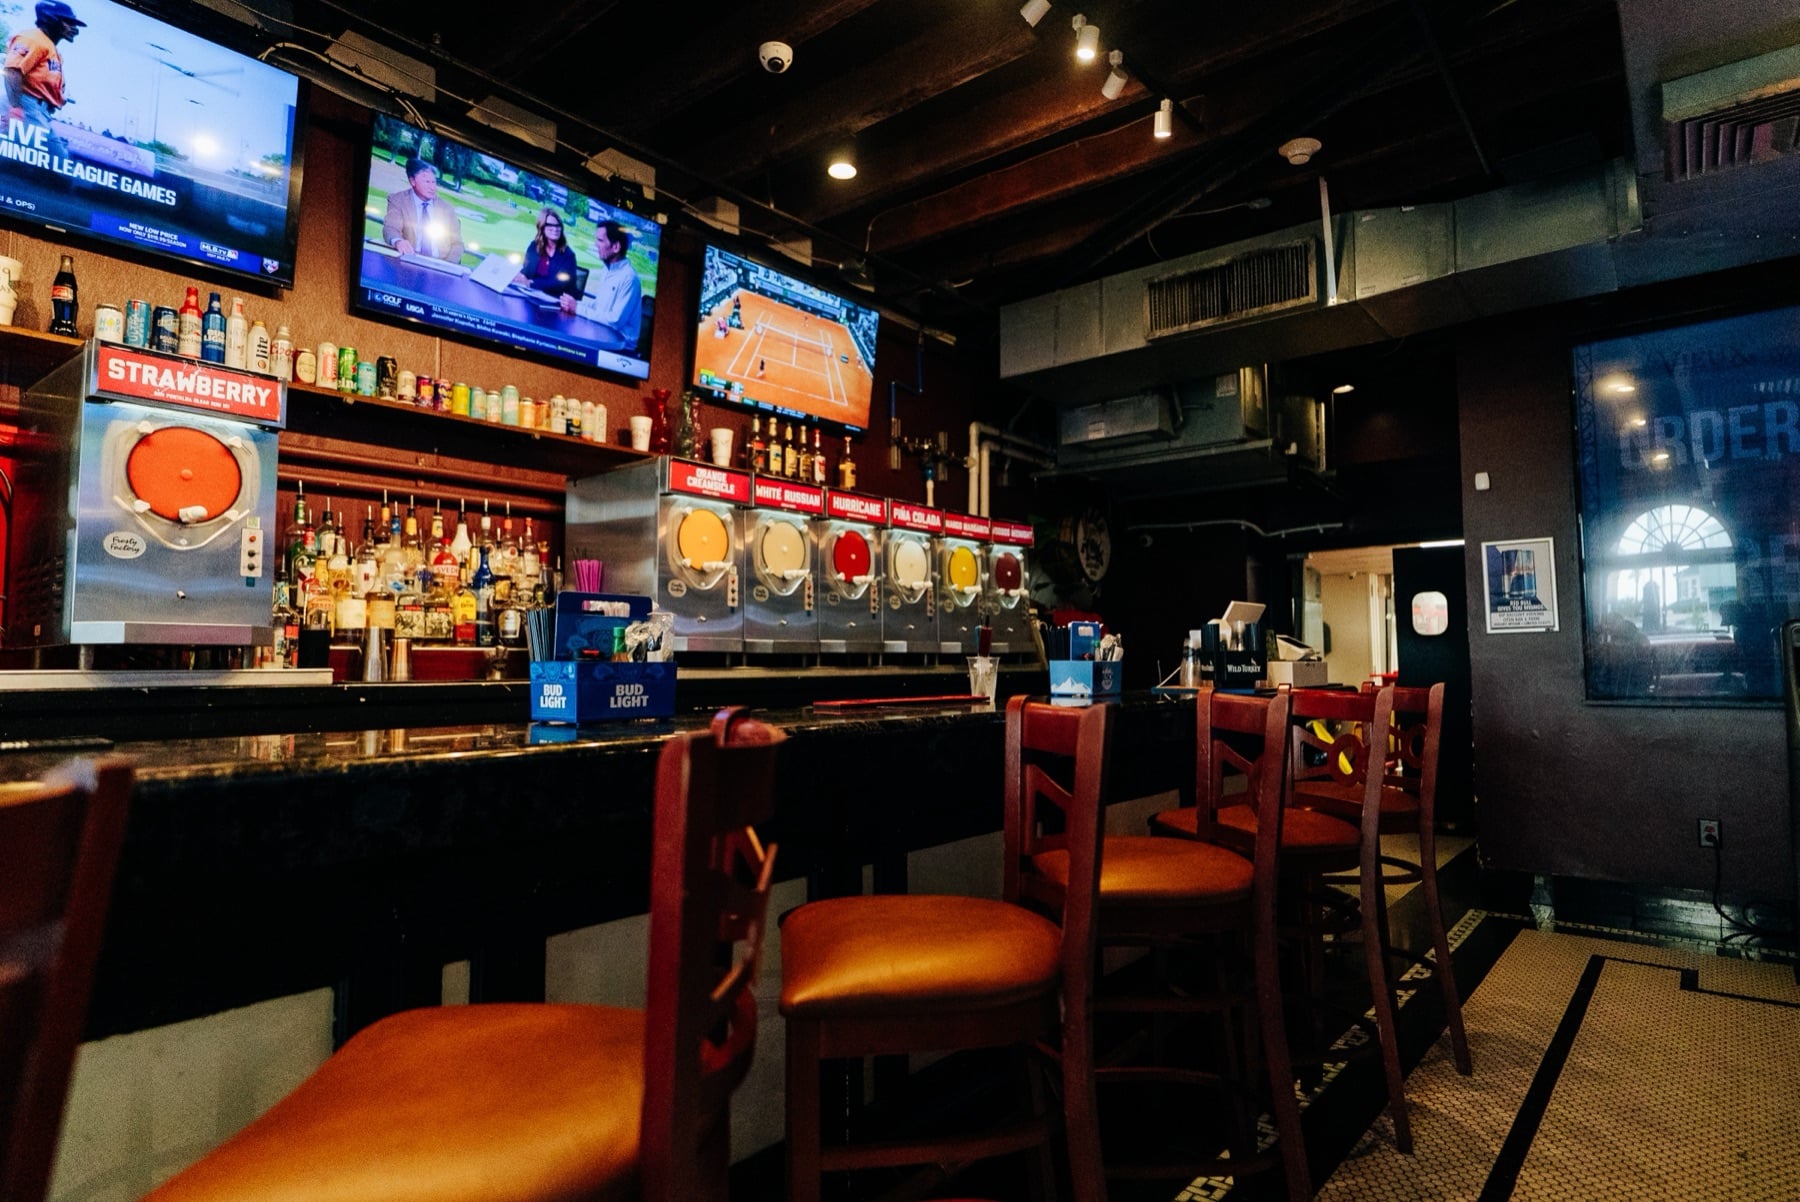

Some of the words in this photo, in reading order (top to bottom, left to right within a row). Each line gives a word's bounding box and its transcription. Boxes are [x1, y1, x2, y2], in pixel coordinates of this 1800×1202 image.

[0, 117, 50, 152] IVE
[52, 155, 119, 190] LEAGUE
[120, 176, 177, 206] GAMES
[15, 199, 36, 211] OPS)
[129, 222, 144, 231] NEW
[145, 226, 159, 235] LOW
[160, 231, 178, 240] PRICE
[383, 294, 402, 304] GOLF
[406, 303, 425, 315] USGA
[256, 336, 268, 359] lite
[108, 357, 272, 407] STRAWBERRY
[696, 467, 728, 483] ORANGE
[686, 475, 735, 495] CREAMSICLE
[755, 484, 782, 500] WHITE
[784, 489, 820, 507] RUSSIAN
[833, 495, 881, 517] HURRICANE
[912, 511, 941, 527] COLADA
[112, 535, 138, 546] Frosty
[110, 543, 140, 554] Factory
[1227, 664, 1241, 673] WILD
[1241, 664, 1261, 673] TURKEY
[543, 684, 563, 696] BUD
[615, 683, 644, 697] BUD
[539, 695, 567, 709] LIGHT
[610, 695, 649, 709] LIGHT
